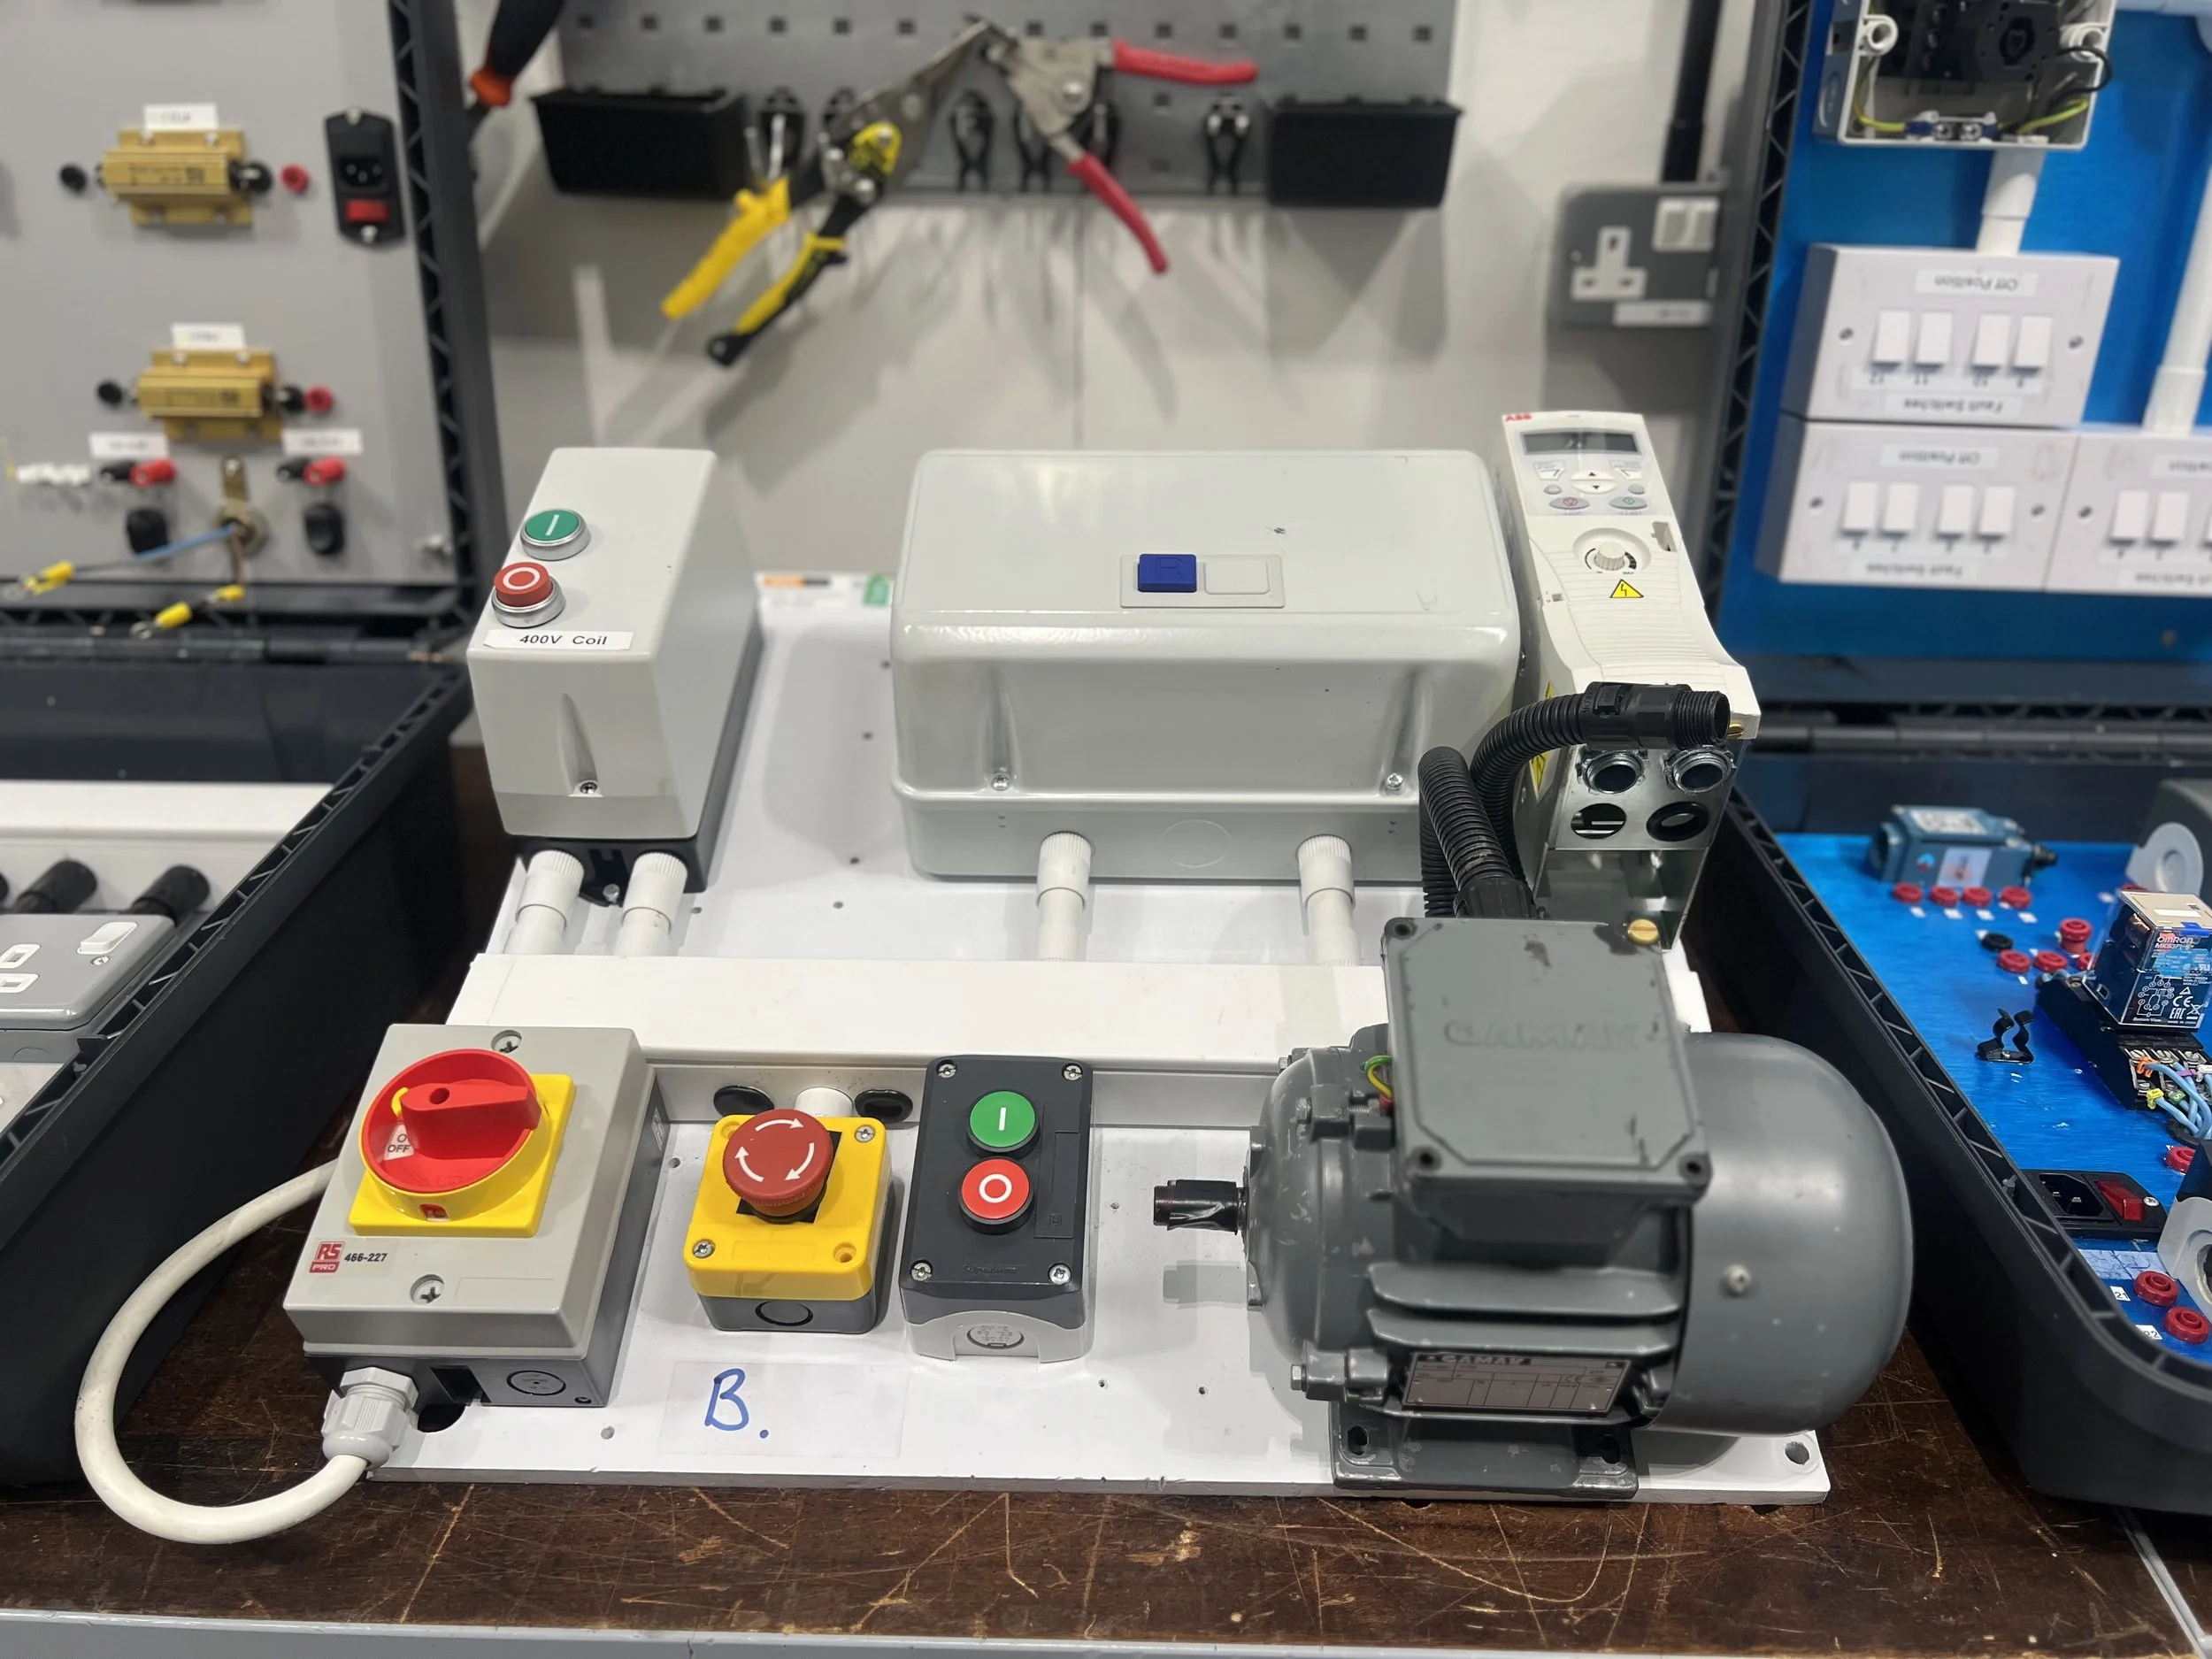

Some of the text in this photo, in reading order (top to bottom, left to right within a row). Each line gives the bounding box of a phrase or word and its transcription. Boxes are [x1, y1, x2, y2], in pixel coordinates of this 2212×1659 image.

[1934, 275, 2019, 291] Off Position
[1903, 397, 2005, 413] Fault Switches
[519, 634, 608, 645] 400V Coil
[387, 1144, 411, 1153] OFF
[316, 1242, 343, 1260] RS
[344, 1253, 388, 1263] 466-227
[1441, 1355, 1525, 1366] GAMAK
[704, 1368, 769, 1439] B.
